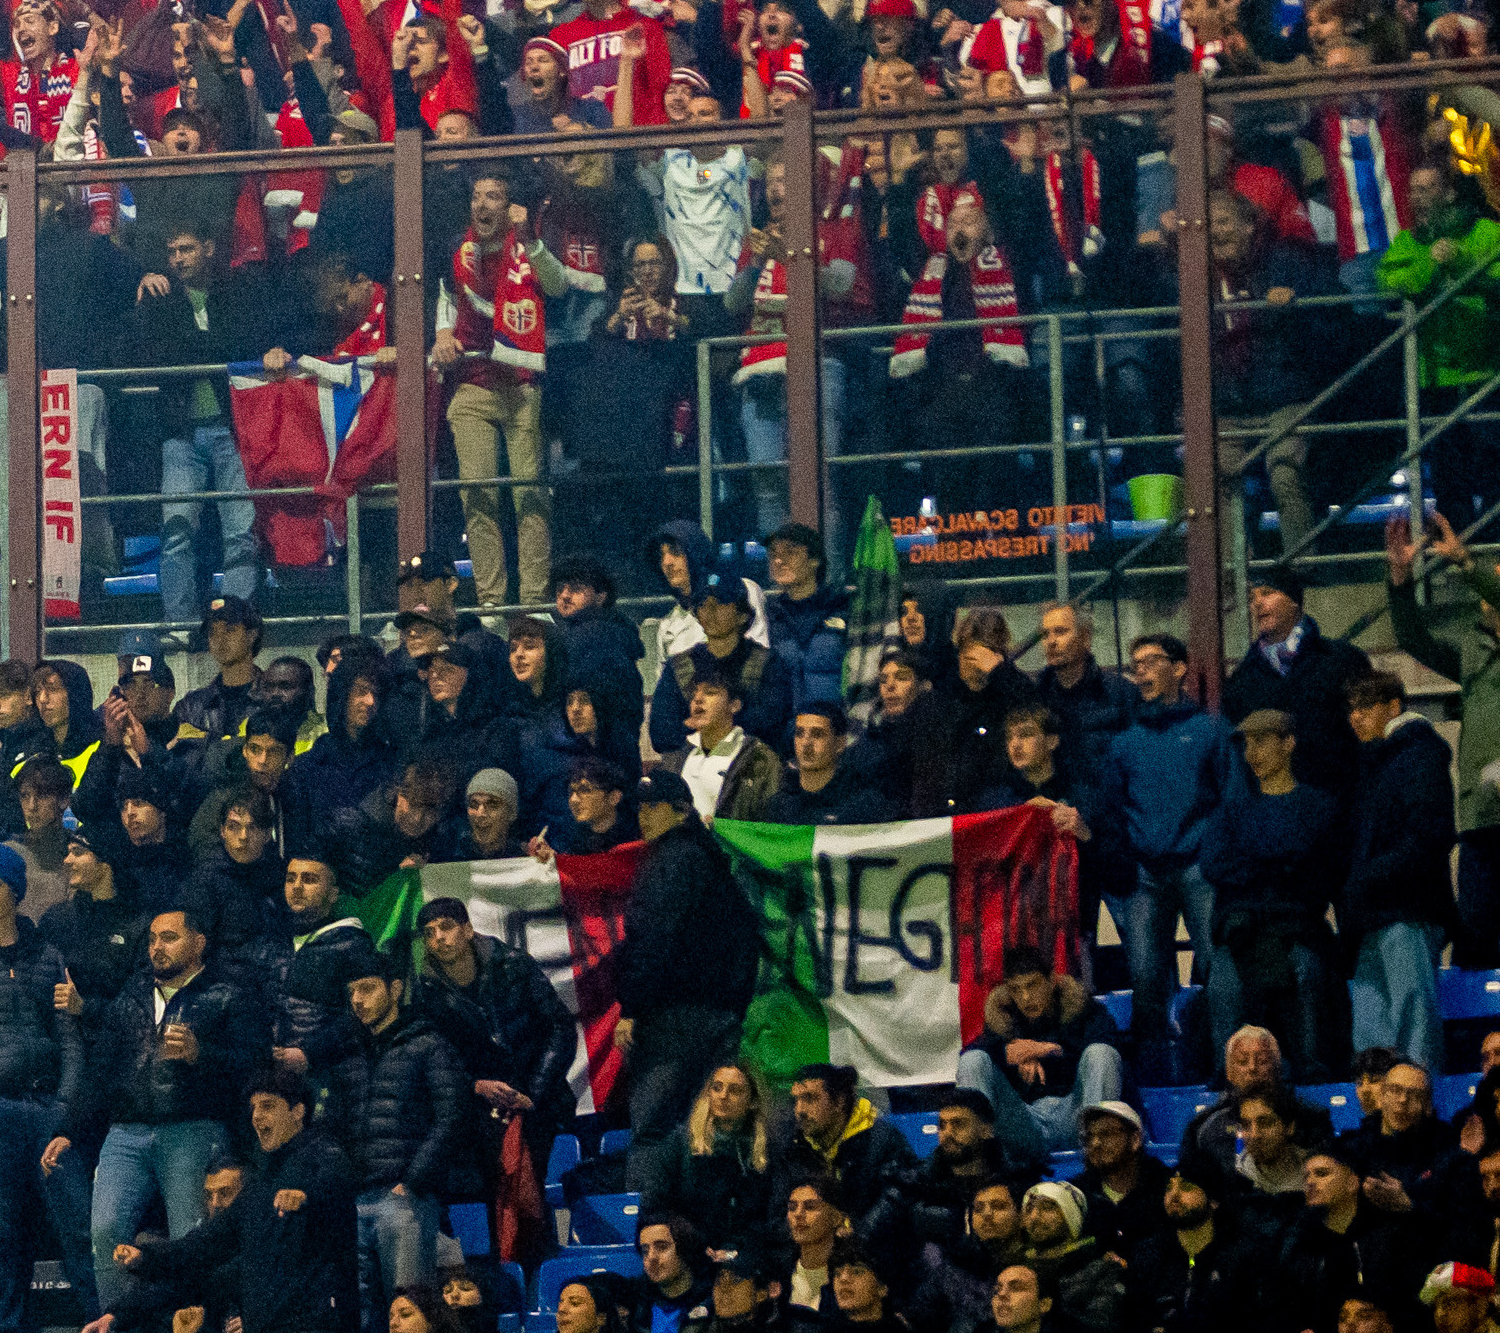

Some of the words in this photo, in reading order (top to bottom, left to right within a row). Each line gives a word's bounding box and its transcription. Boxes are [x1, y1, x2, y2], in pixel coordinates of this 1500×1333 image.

[569, 40, 596, 70] ALT
[599, 34, 624, 58] FO
[41, 370, 72, 480] ERN
[45, 500, 74, 544] IF
